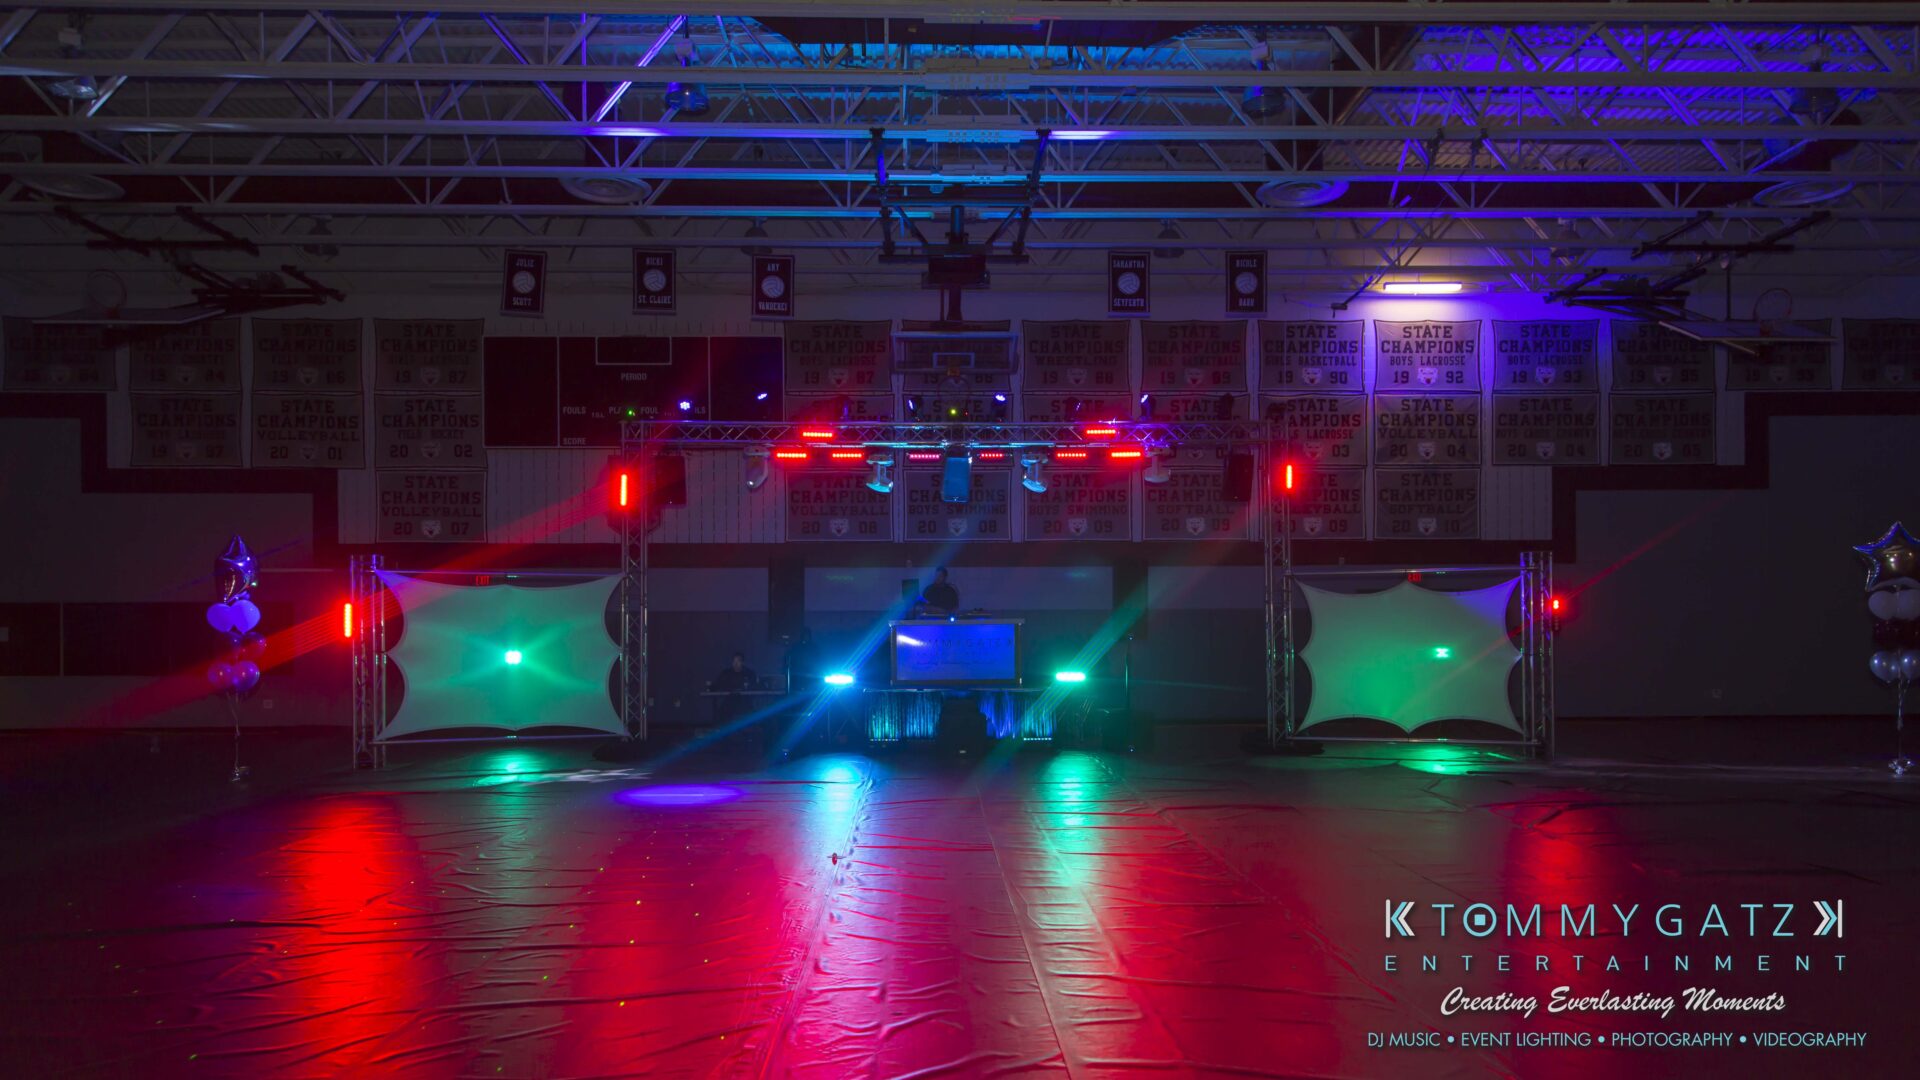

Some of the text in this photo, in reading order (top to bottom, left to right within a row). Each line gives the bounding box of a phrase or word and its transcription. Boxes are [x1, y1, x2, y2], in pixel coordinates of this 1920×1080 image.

[767, 263, 779, 272] AMY
[1113, 259, 1144, 269] SAMANTHA
[1236, 259, 1257, 267] NICOLE
[649, 294, 671, 304] CLAIRE
[281, 324, 334, 337] STATE
[403, 324, 456, 337] STATE
[812, 325, 864, 338] STATE
[1051, 325, 1101, 338] STATE
[1169, 326, 1220, 338] STATE
[1286, 326, 1337, 338] STATE
[1403, 326, 1452, 338] STATE
[1521, 325, 1571, 338] STATE
[258, 339, 357, 352] CHAMPIONS
[380, 339, 478, 352] CHAMPIONS
[790, 340, 886, 353] CHAMPIONS
[1030, 340, 1124, 353] CHAMPIONS
[1148, 340, 1241, 353] CHAMPIONS
[1264, 340, 1358, 353] CHAMPIONS
[1381, 340, 1474, 353] CHAMPIONS
[1500, 340, 1592, 353] CHAMPIONS
[1035, 356, 1118, 366] WRESTLING
[1265, 356, 1356, 366] GIRLS BASKETBALL
[1390, 356, 1465, 366] BOYS LACROSSE
[1507, 356, 1584, 365] BOYS LACROSSE
[621, 372, 647, 381] PERIOD
[803, 371, 819, 384] 19
[1043, 372, 1058, 384] 19
[1160, 372, 1175, 384] 19
[1278, 371, 1347, 384] 19 90
[1393, 371, 1464, 384] 19 92
[1511, 370, 1582, 383] 19 93
[1629, 370, 1645, 383] 19
[160, 400, 213, 412] STATE
[281, 401, 335, 413] STATE
[405, 400, 456, 413] STATE
[563, 406, 586, 415] FOULS
[1287, 399, 1338, 412] STATE
[1402, 399, 1453, 411] STATE
[1520, 399, 1572, 412] STATE
[1637, 399, 1689, 412] STATE
[138, 414, 236, 427] CHAMPIONS
[258, 415, 359, 429] CHAMPIONS
[382, 414, 479, 428] CHAMPIONS
[1287, 414, 1361, 426] AMPIONS
[1380, 414, 1477, 426] CHAMPIONS
[1499, 414, 1595, 426] CHAMPIONS
[1615, 414, 1712, 426] CHAMPIONS
[257, 431, 360, 441] VOLLEYBALL
[1306, 430, 1354, 439] LACROSSE
[1378, 429, 1478, 439] VOLLEYBALL
[563, 437, 586, 445] SCORE
[270, 447, 342, 460] 20 01
[390, 445, 473, 458] 20 02
[1332, 445, 1349, 457] 03
[1390, 444, 1466, 457] 20 04
[1508, 444, 1526, 457] 20
[1624, 444, 1642, 457] 20
[404, 475, 458, 488] STATE
[813, 475, 865, 488] STATE
[1053, 474, 1099, 488] STAT
[1170, 474, 1222, 487] STATE
[1402, 473, 1453, 486] STATE
[382, 491, 481, 504] CHAMPIONS
[791, 490, 887, 503] CHAMPIONS
[909, 490, 1006, 502] CHAIONS
[1030, 489, 1126, 502] CHAMPIONS
[1148, 489, 1224, 501] CHAMPIO
[1379, 488, 1476, 501] CHAMPIONS
[381, 507, 482, 517] VOLLEYBALL
[791, 506, 889, 516] VOLLEYBALL
[909, 506, 1006, 514] BOYS SWIMMING
[1029, 505, 1127, 515] BOYS SWIMMING
[1157, 505, 1235, 514] SOFTBALL
[1389, 504, 1464, 514] SOFTBALL
[393, 522, 469, 535] 20 07
[802, 521, 877, 534] 20 08
[918, 520, 997, 533] 20 08
[1043, 520, 1113, 533] 20 09
[1161, 518, 1230, 531] 20 09
[1329, 520, 1348, 532] 09
[1392, 519, 1461, 532] 20 10
